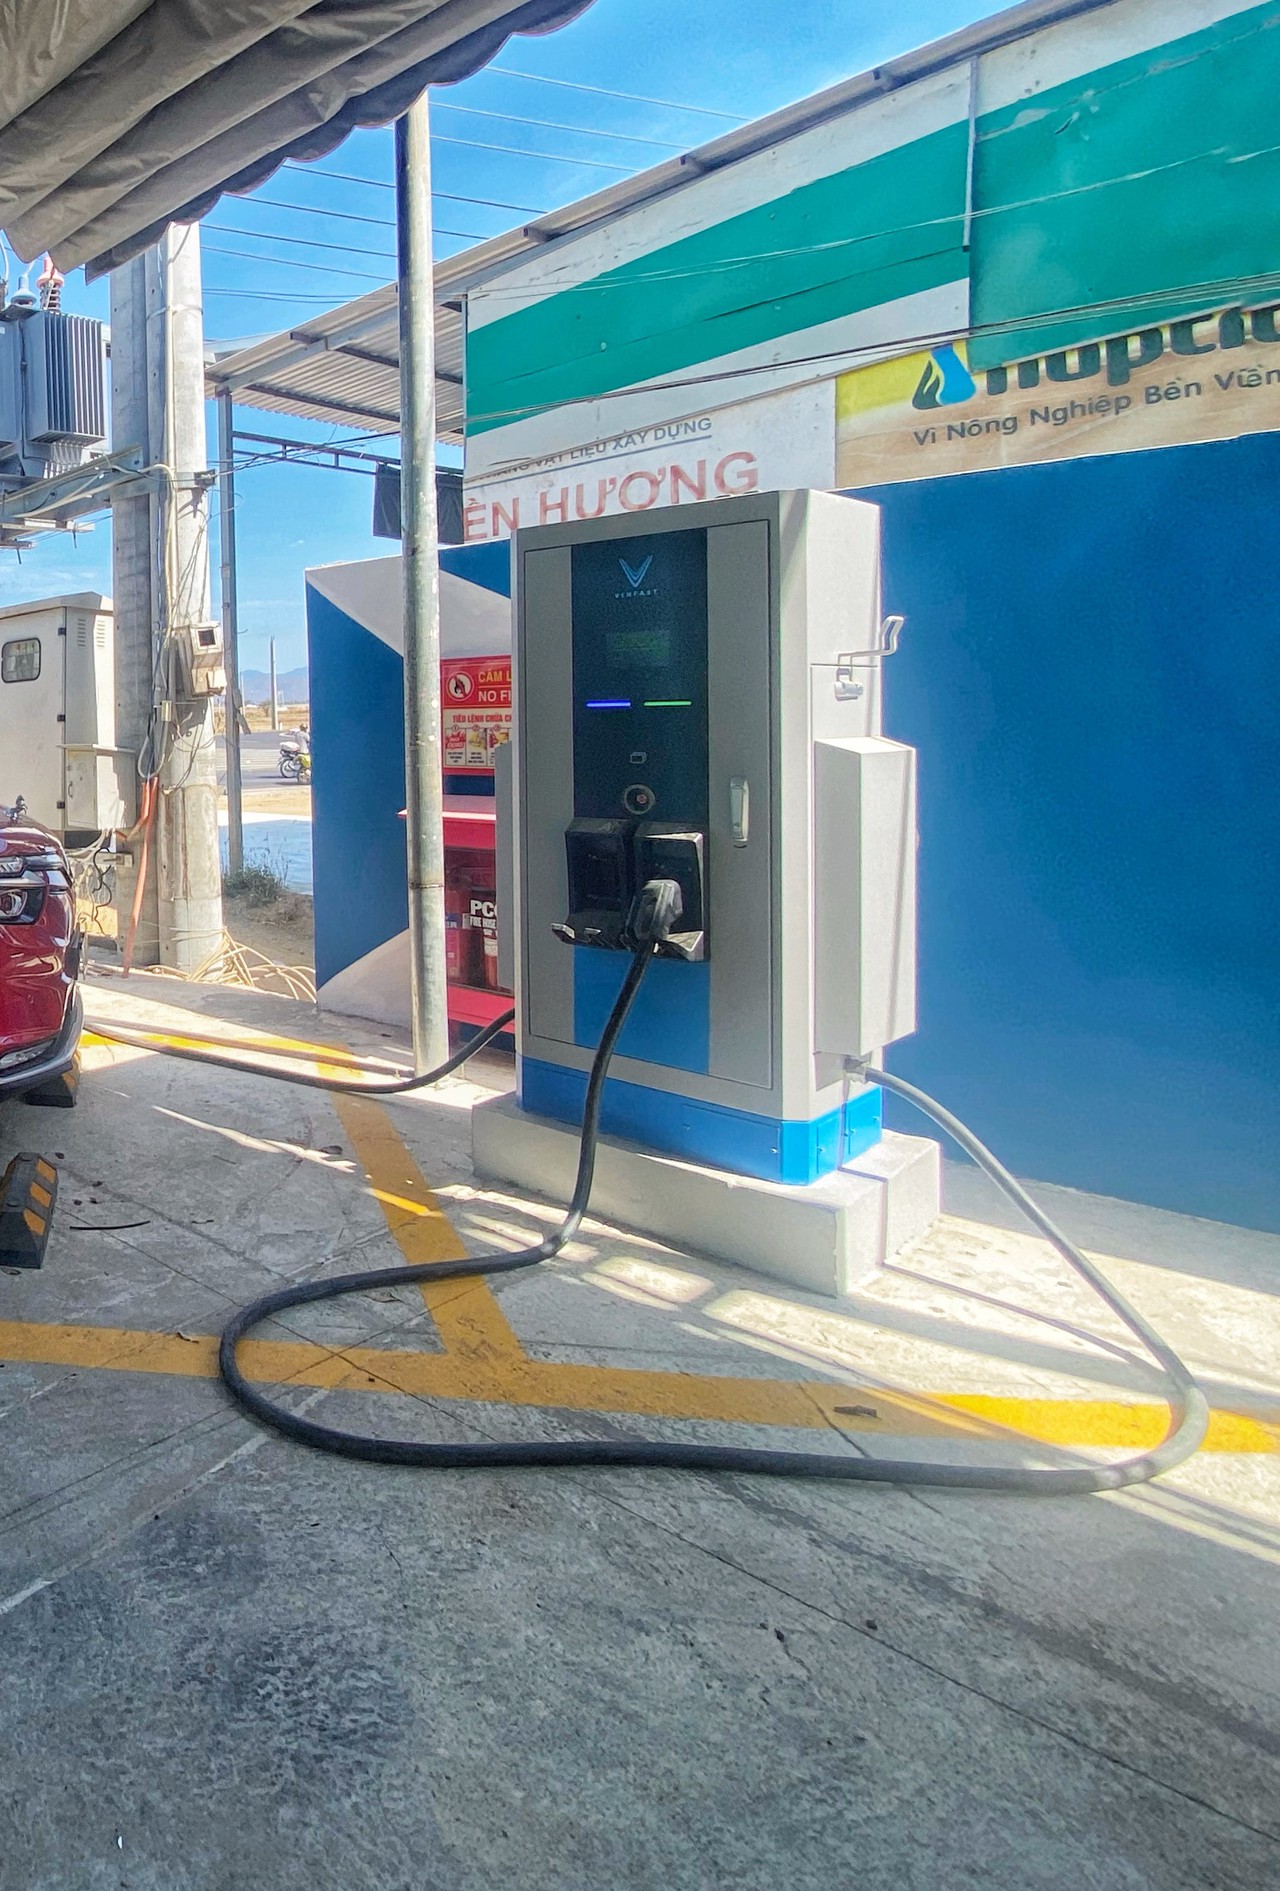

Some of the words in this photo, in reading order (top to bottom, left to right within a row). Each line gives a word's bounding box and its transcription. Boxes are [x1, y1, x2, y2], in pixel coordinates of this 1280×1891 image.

[947, 416, 1018, 441] Nông
[1030, 394, 1132, 426] Nghiệp
[1144, 377, 1202, 405] Bền
[654, 417, 712, 441] DỰNG
[539, 451, 758, 525] HƯƠNG
[478, 668, 502, 682] CẤM
[478, 690, 497, 702] NO
[470, 899, 497, 918] PC
